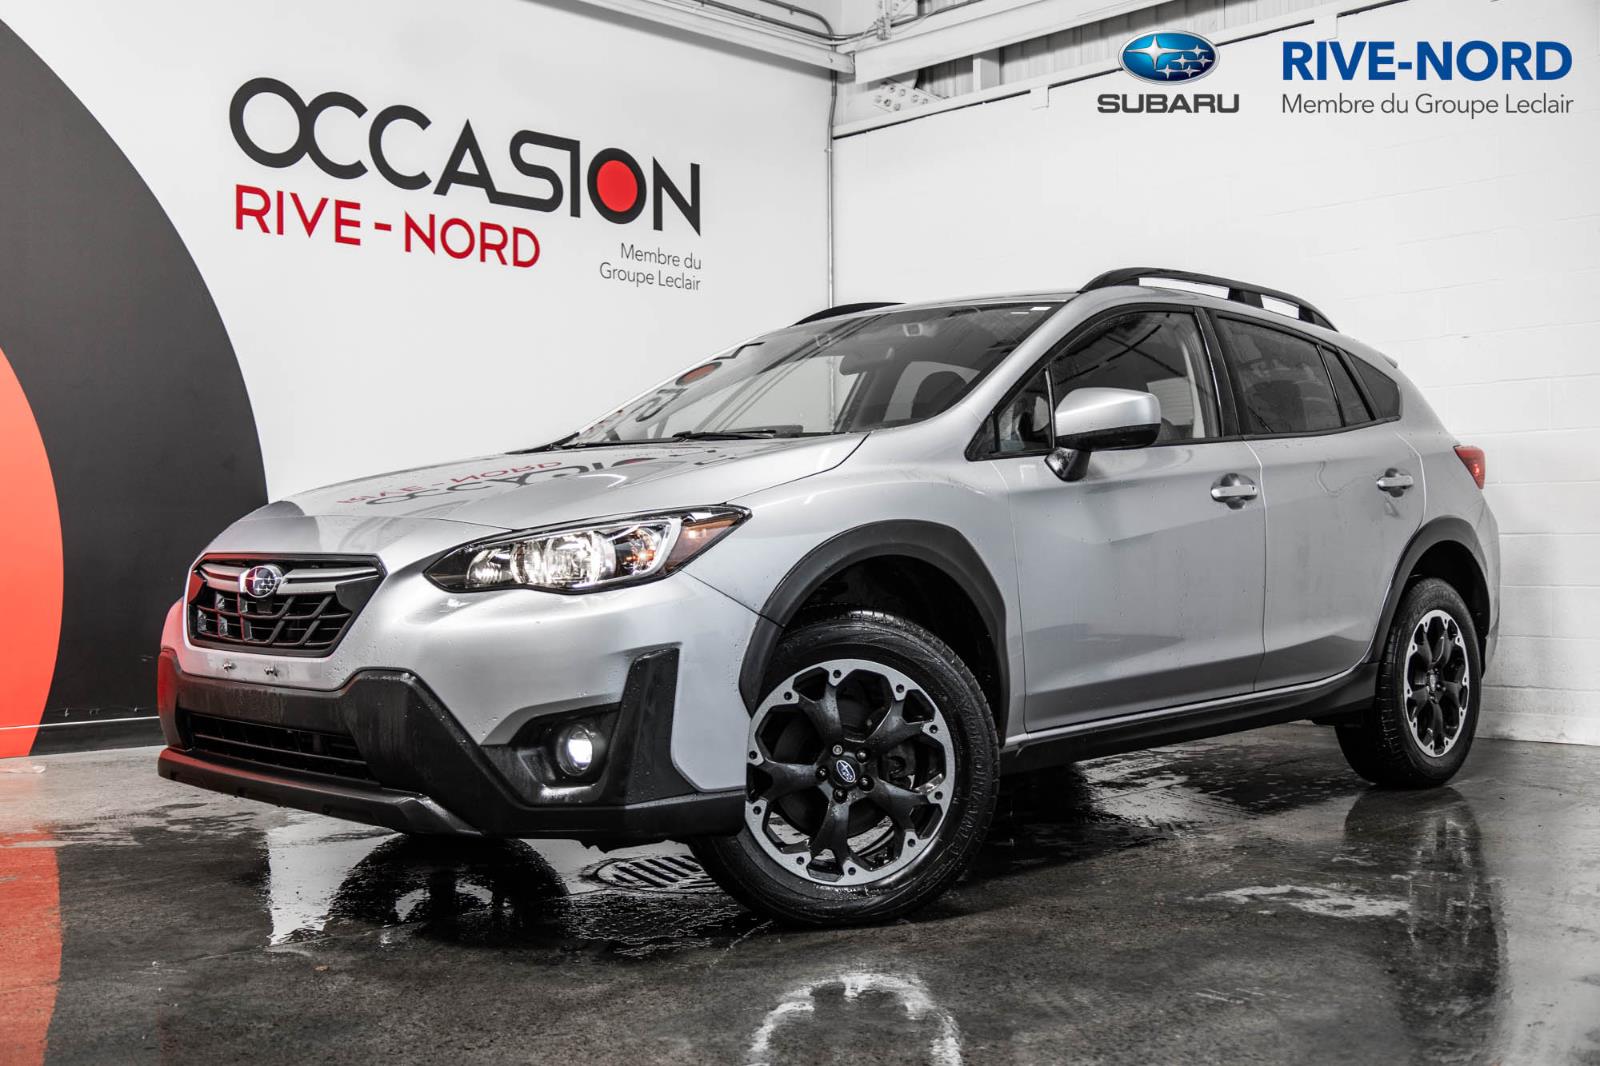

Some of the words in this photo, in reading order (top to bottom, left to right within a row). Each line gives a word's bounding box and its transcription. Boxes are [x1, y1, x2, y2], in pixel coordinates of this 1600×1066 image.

[230, 77, 701, 236] OCCASION
[620, 242, 681, 267] Membre
[683, 252, 701, 270] du
[599, 261, 655, 288] Groupe
[658, 270, 701, 290] Leclair
